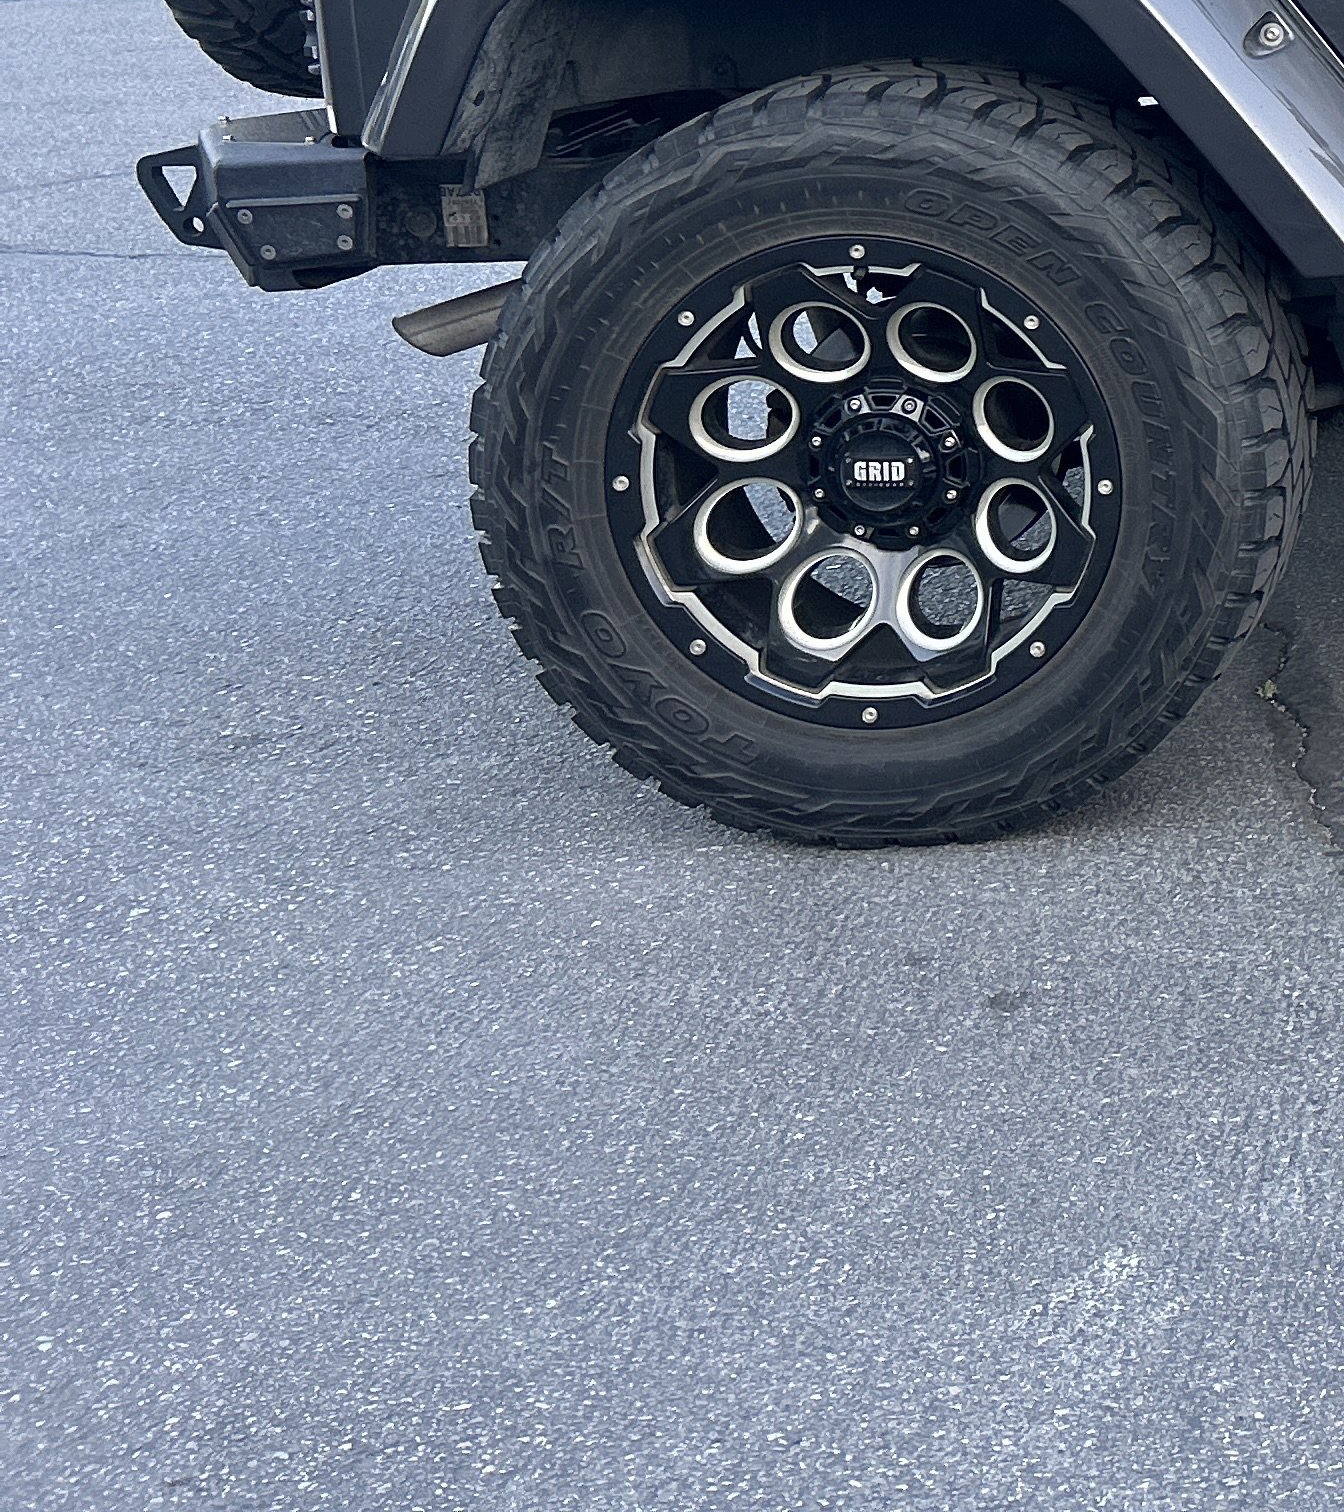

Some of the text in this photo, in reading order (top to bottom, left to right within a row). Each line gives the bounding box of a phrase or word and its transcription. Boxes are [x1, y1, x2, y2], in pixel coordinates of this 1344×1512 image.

[854, 461, 905, 481] GRID
[904, 188, 1177, 595] OPEN COUNTRY
[541, 441, 759, 766] TOYO R/T
